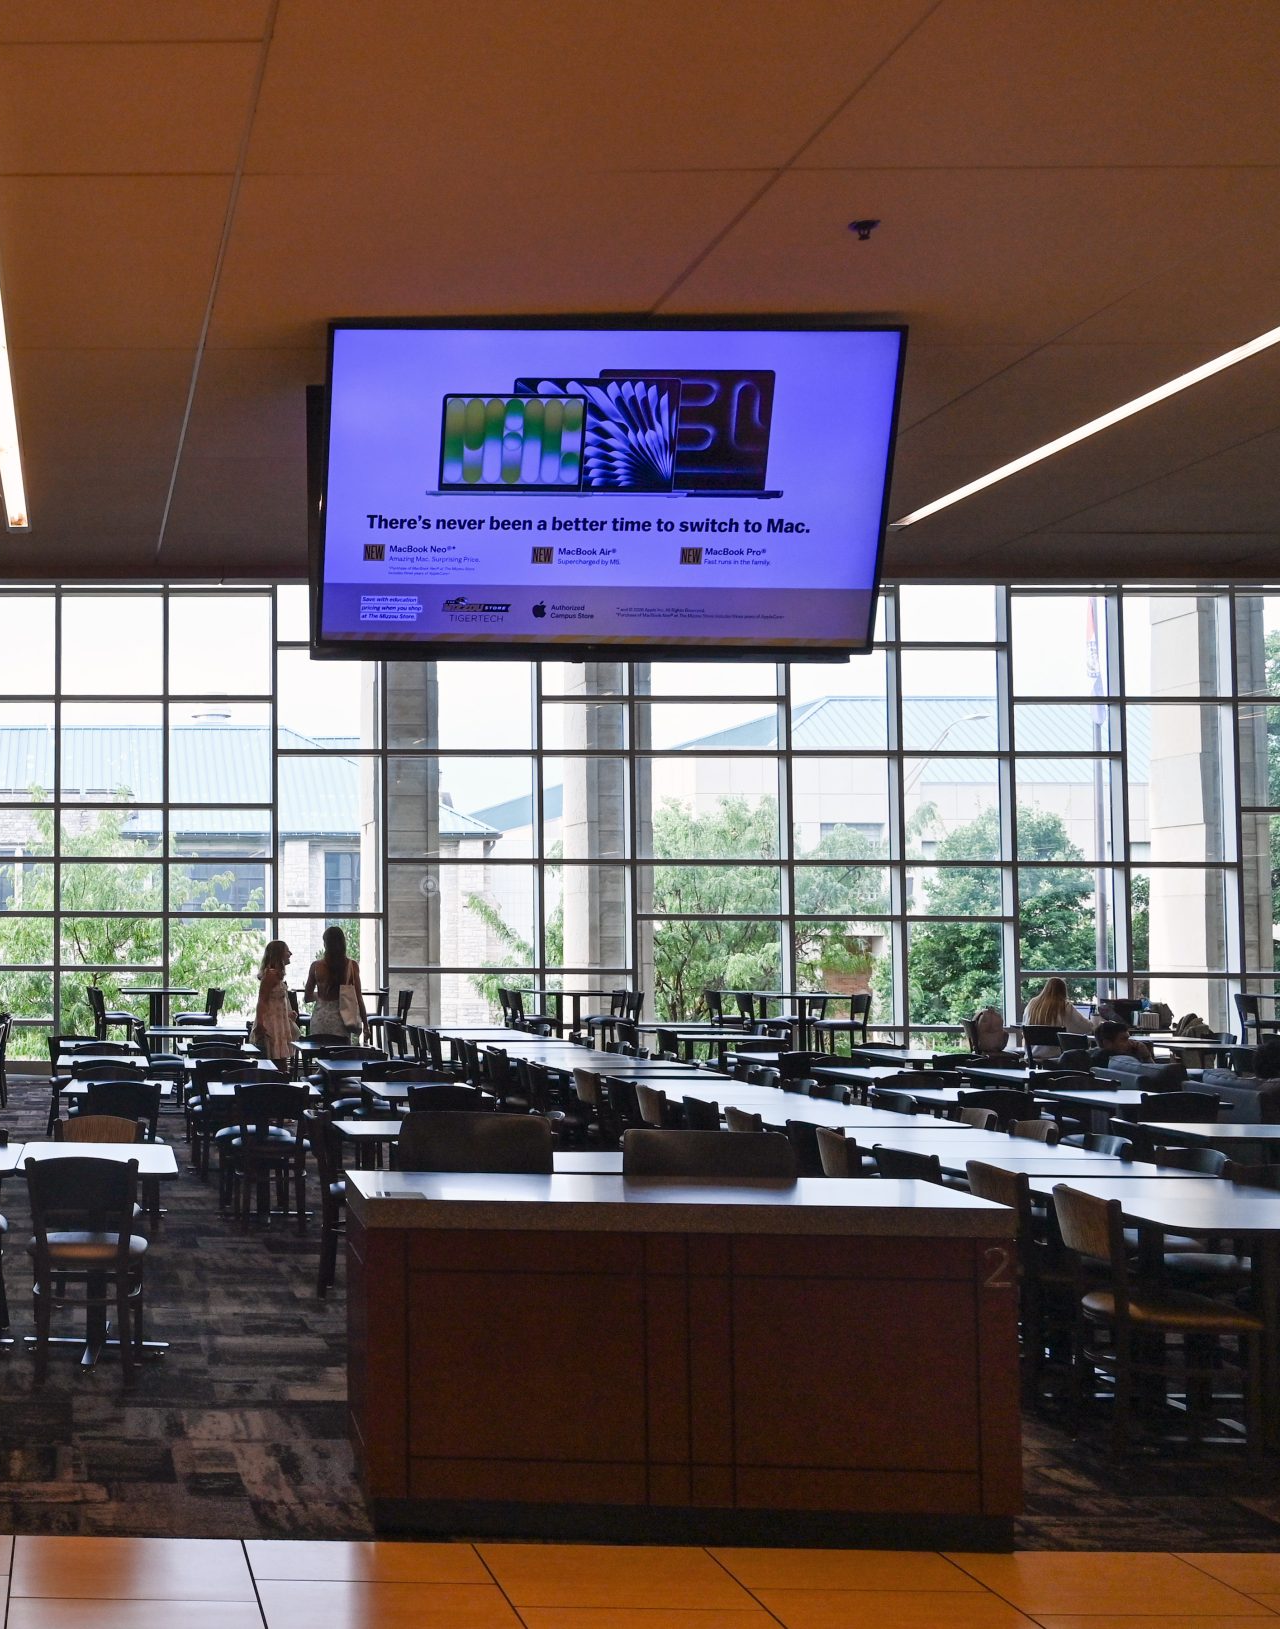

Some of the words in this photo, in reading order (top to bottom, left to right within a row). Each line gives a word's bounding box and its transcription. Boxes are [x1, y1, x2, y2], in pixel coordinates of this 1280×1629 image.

[367, 514, 431, 530] There's
[436, 517, 485, 531] never
[489, 515, 533, 531] been
[537, 520, 547, 531] a
[551, 516, 607, 532] better
[612, 517, 651, 532] time
[657, 518, 675, 532] to
[679, 517, 739, 533] switch
[744, 519, 762, 534] to
[767, 518, 810, 534] Mac.
[366, 545, 385, 560] NEW
[389, 545, 428, 553] MacBook
[532, 547, 553, 563] NEW
[558, 547, 597, 556] MacBook
[705, 547, 744, 556] MacBook
[681, 547, 702, 564] NEW
[551, 604, 585, 612] Authorized
[450, 614, 504, 623] TIGERTECH
[984, 1247, 1012, 1288] 2
